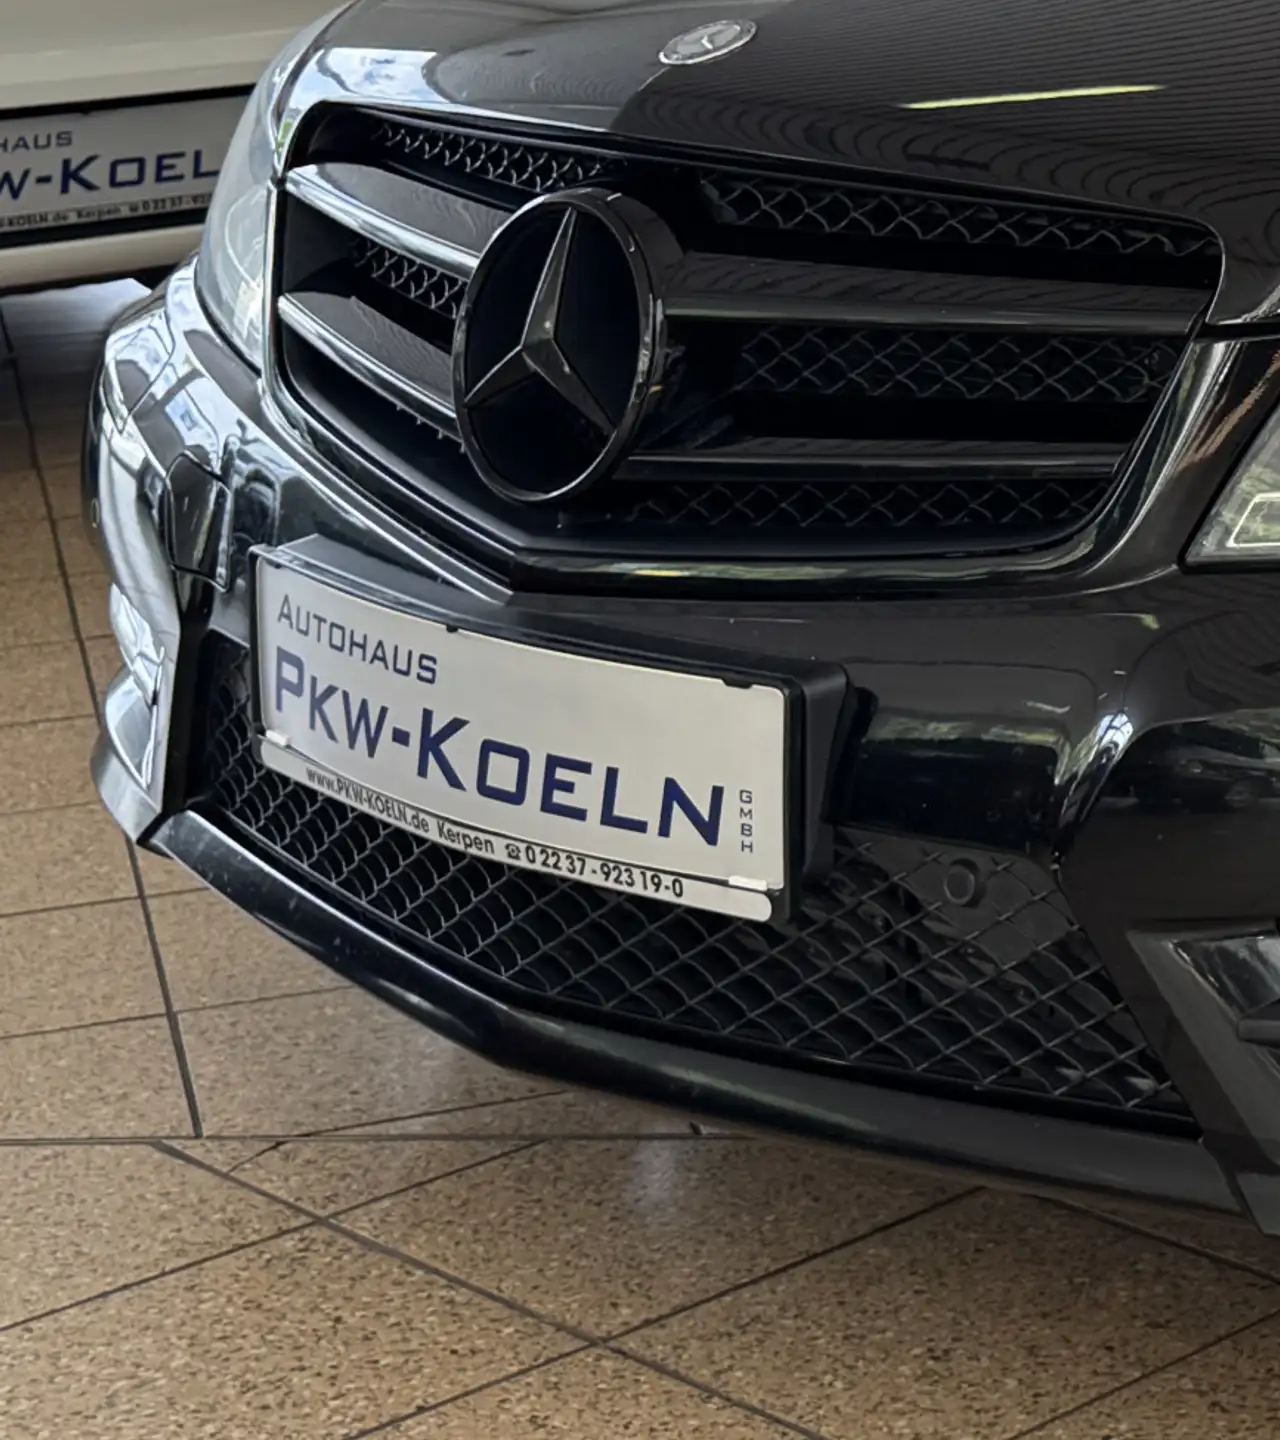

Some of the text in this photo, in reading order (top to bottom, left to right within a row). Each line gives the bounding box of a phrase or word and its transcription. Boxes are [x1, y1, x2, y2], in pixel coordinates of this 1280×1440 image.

[277, 593, 438, 685] AUTOHAUS
[274, 645, 726, 847] PKW-KOELN
[306, 767, 430, 834] www.PKW-KOELN.de
[437, 819, 496, 855] Kerpen
